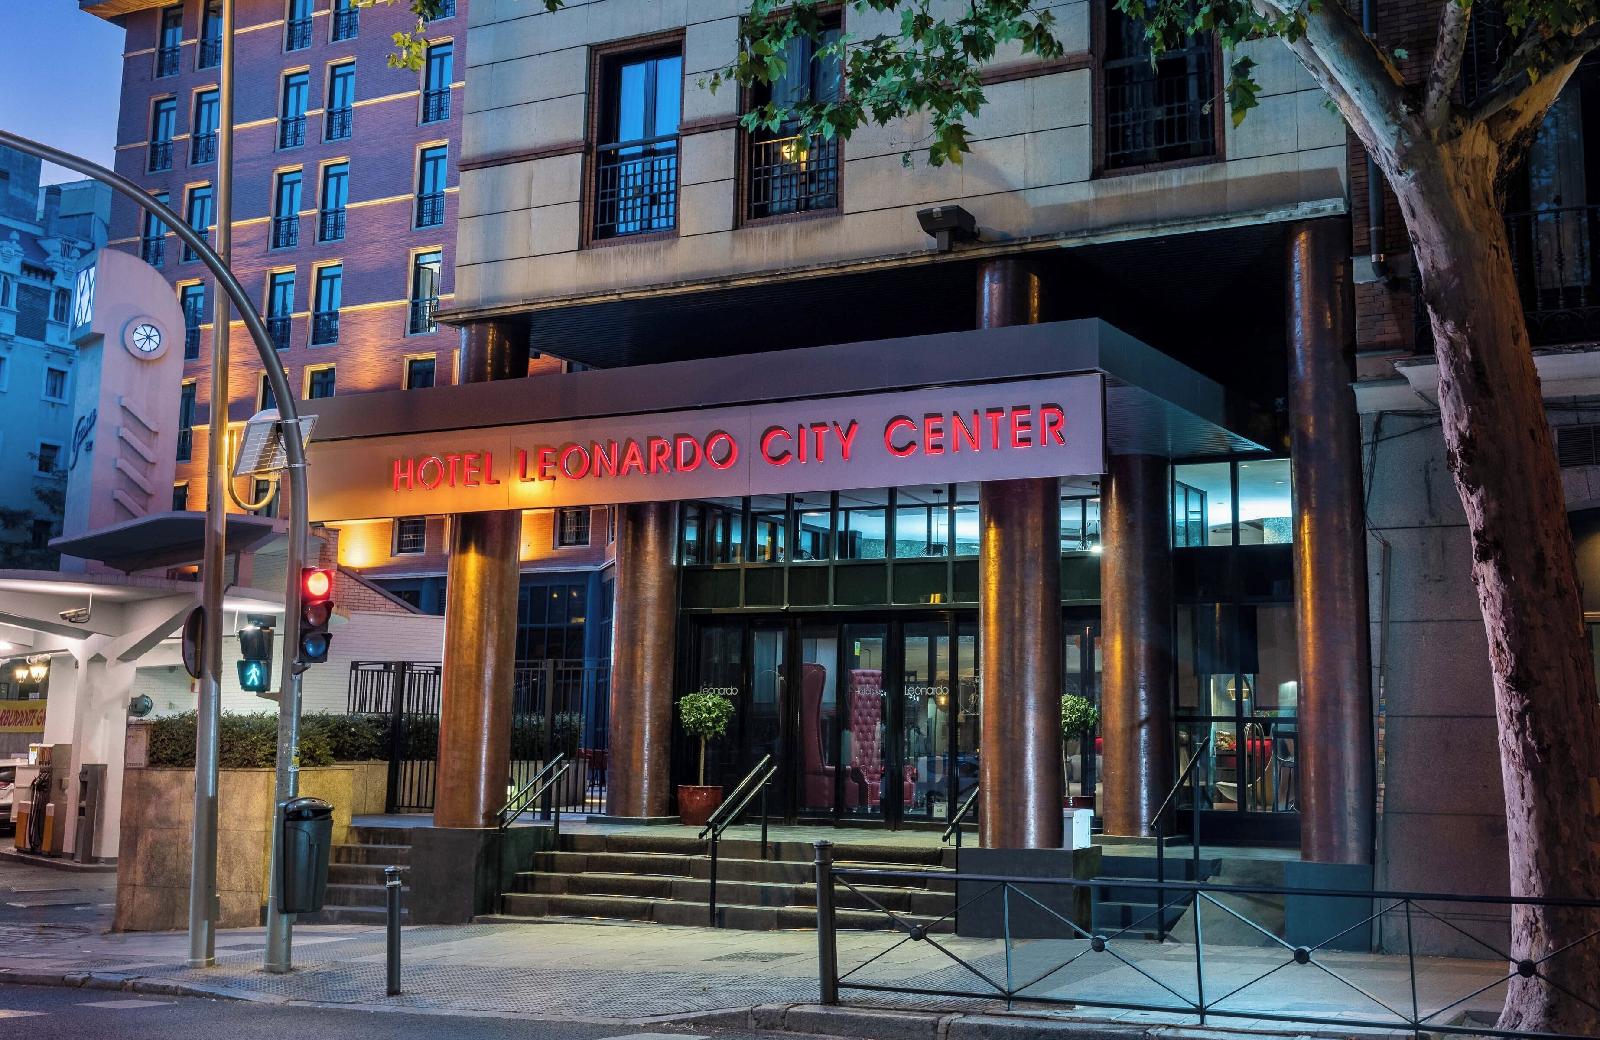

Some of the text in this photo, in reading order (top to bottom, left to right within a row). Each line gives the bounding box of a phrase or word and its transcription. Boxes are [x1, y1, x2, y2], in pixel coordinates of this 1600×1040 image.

[392, 403, 1066, 492] HOTEL LEONARDO CITY CENTER
